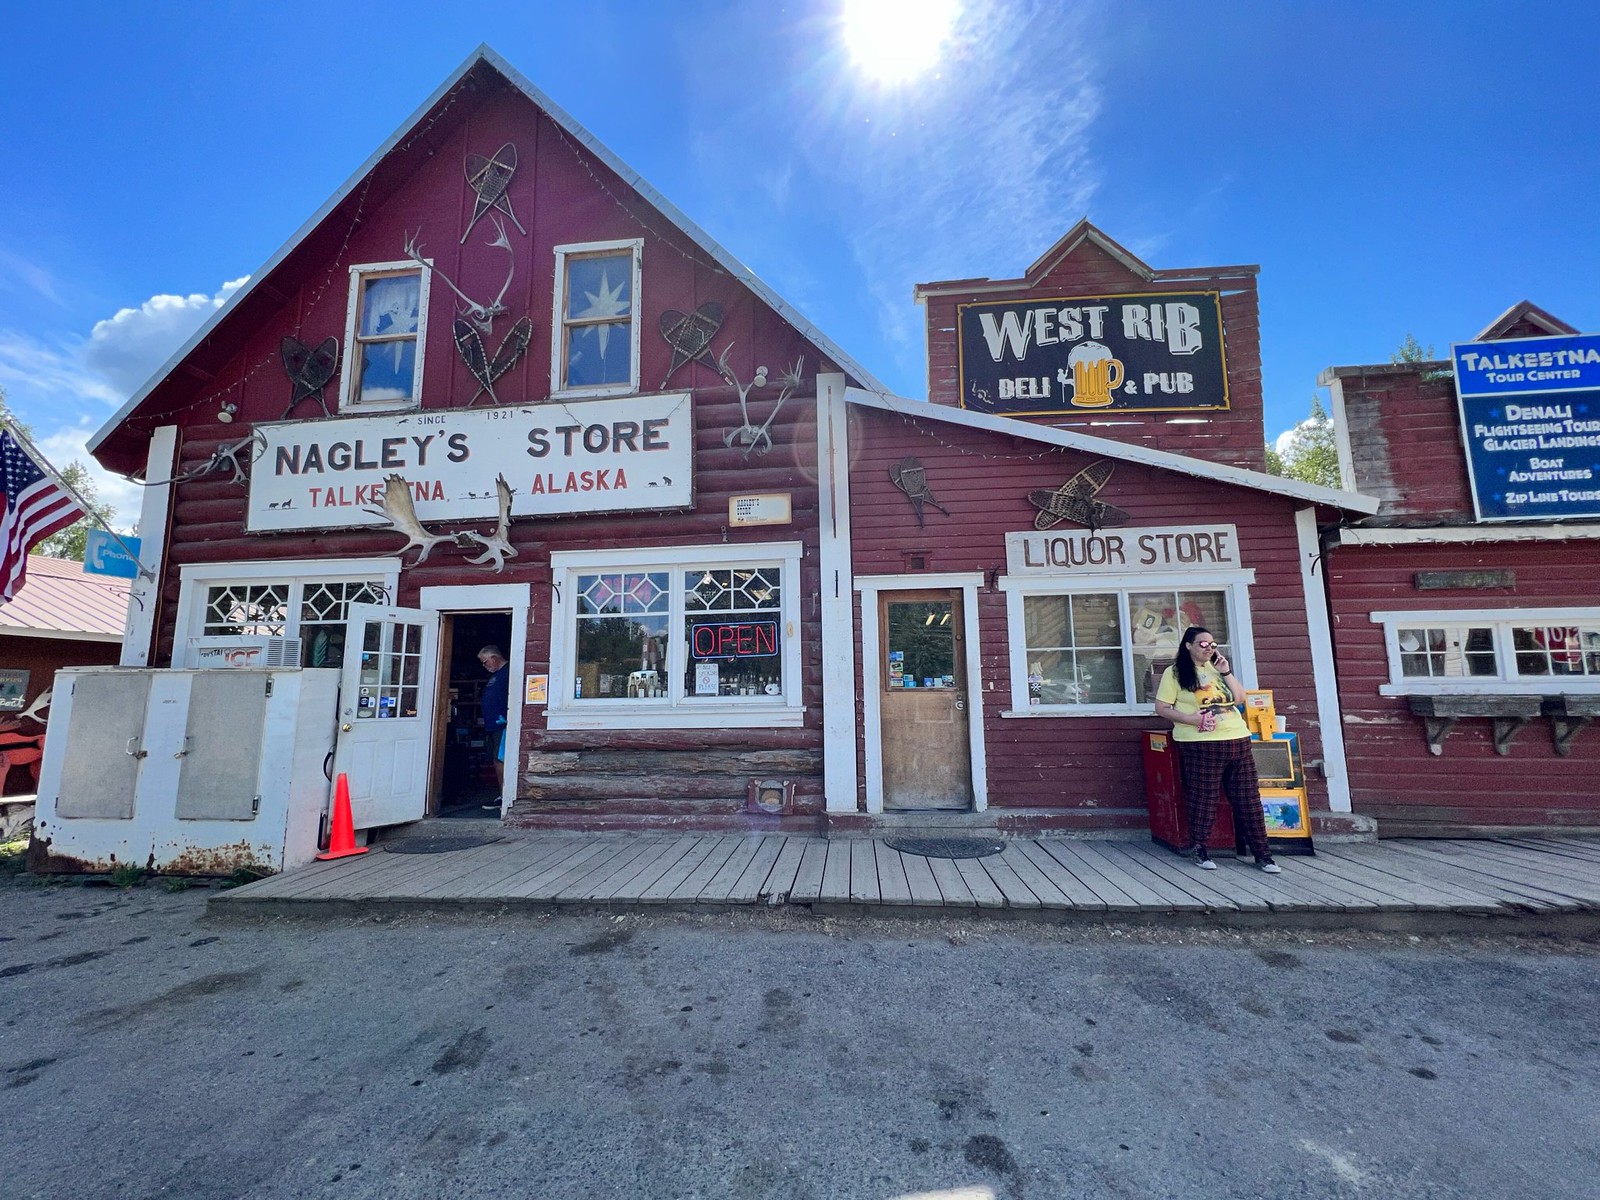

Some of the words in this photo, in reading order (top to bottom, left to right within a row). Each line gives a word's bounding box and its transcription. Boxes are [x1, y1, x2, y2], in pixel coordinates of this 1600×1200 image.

[979, 305, 1109, 362] WEST
[1121, 302, 1202, 356] RIB
[1461, 349, 1600, 371] TALKEETNA
[1486, 372, 1525, 384] TOUR
[1527, 369, 1581, 382] CENTER
[998, 376, 1051, 399] DELI
[1124, 380, 1138, 395] &
[1143, 372, 1194, 395] PUB
[417, 415, 446, 425] SINCE
[487, 410, 513, 420] 1921
[1505, 405, 1572, 421] DENALI
[1475, 423, 1562, 438] FLIGHTSEEING
[275, 430, 470, 476] NAGLEY'S
[526, 418, 670, 458] STORE
[1484, 437, 1537, 451] GLACIER
[1529, 457, 1564, 470] BOAT
[1509, 469, 1592, 482] ADVENTURES
[309, 480, 450, 507] TALKENA,
[532, 468, 628, 495] ALASKA
[1505, 492, 1527, 504] ZIP
[1530, 491, 1559, 503] LINE
[1023, 536, 1126, 568] LIQUOR
[1138, 532, 1232, 565] STORE
[695, 624, 775, 655] OPEN
